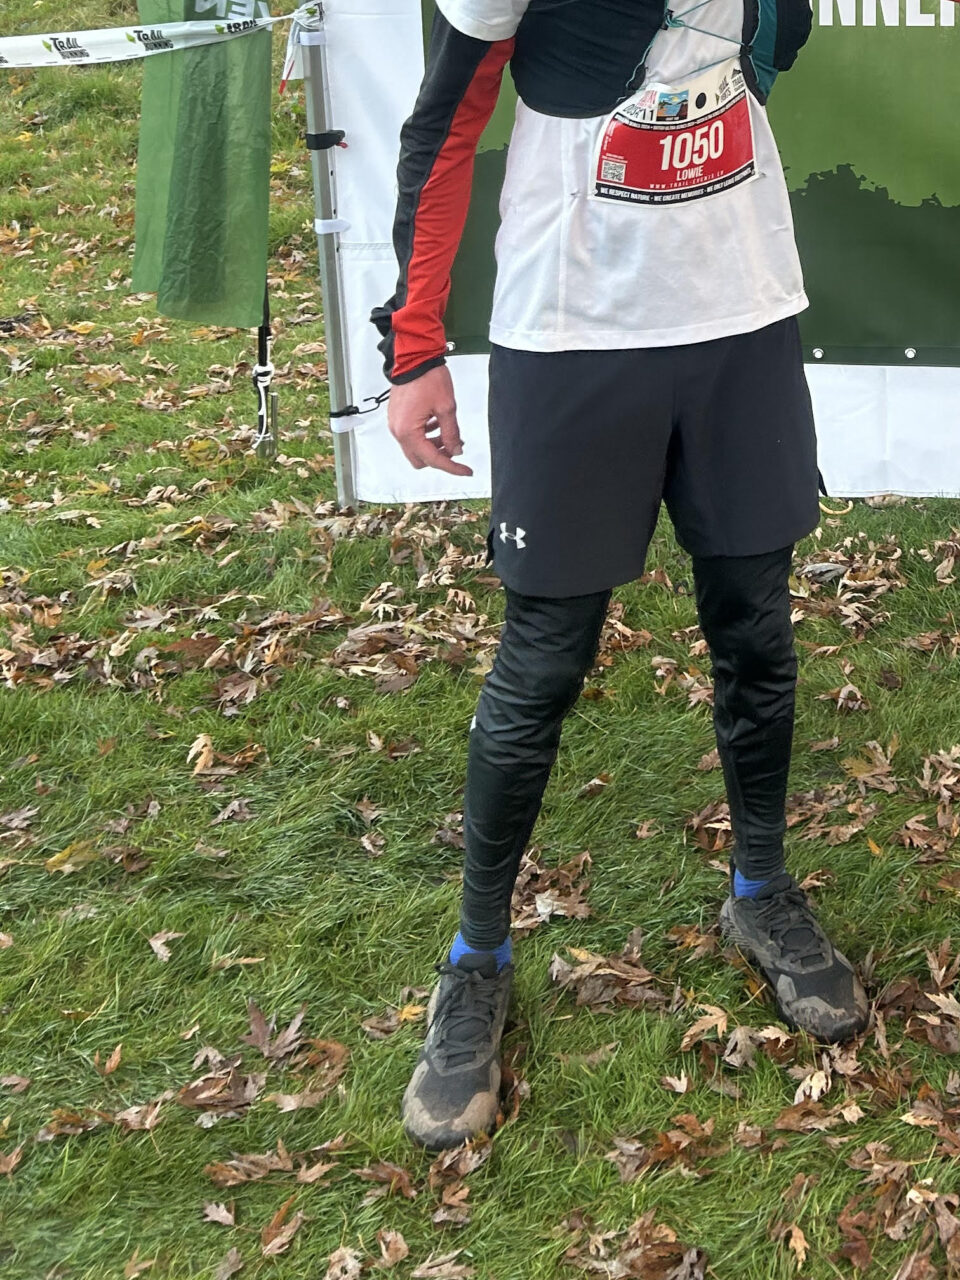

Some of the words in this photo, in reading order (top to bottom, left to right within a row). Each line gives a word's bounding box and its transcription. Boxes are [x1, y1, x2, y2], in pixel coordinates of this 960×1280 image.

[49, 37, 82, 52] TRAIL
[659, 120, 724, 171] 1050
[676, 165, 705, 181] LOWIE
